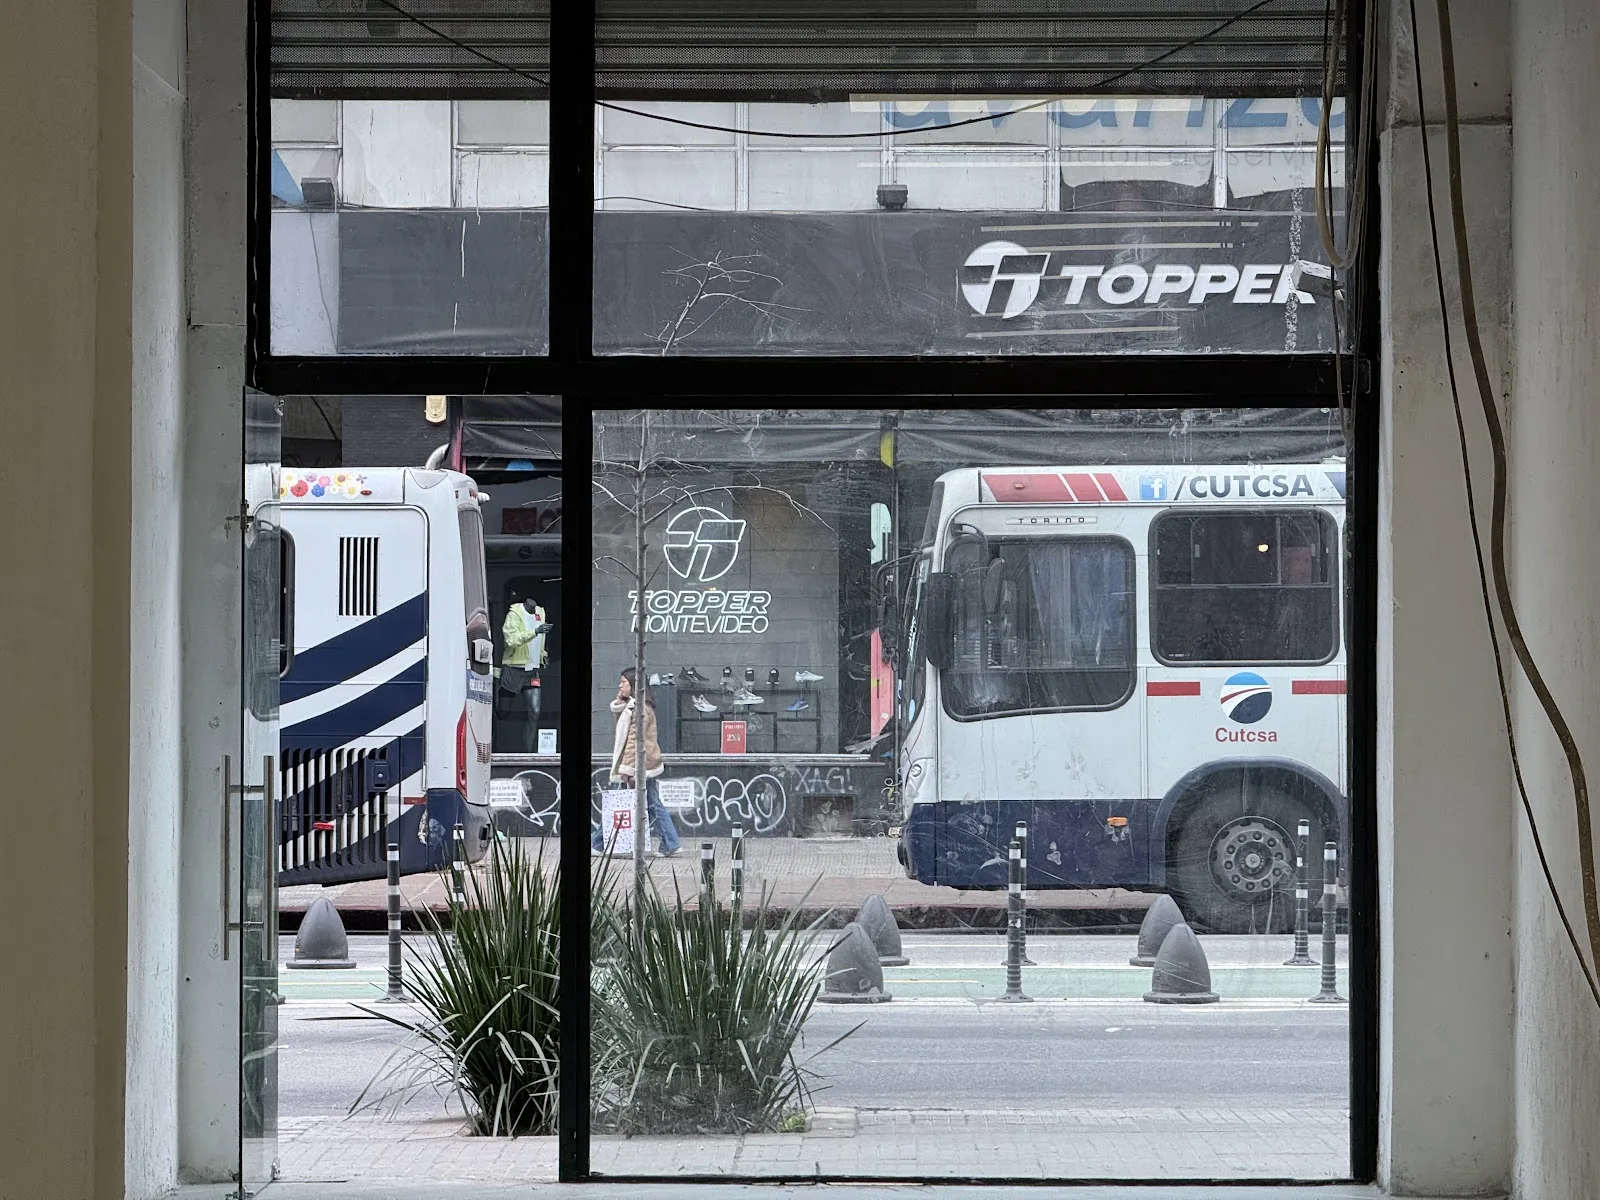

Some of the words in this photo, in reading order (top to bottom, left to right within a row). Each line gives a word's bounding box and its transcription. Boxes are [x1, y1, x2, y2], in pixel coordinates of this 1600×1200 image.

[1018, 516, 1086, 524] TORINO
[627, 590, 772, 614] TOPPER
[1214, 727, 1279, 743] Cutcsa
